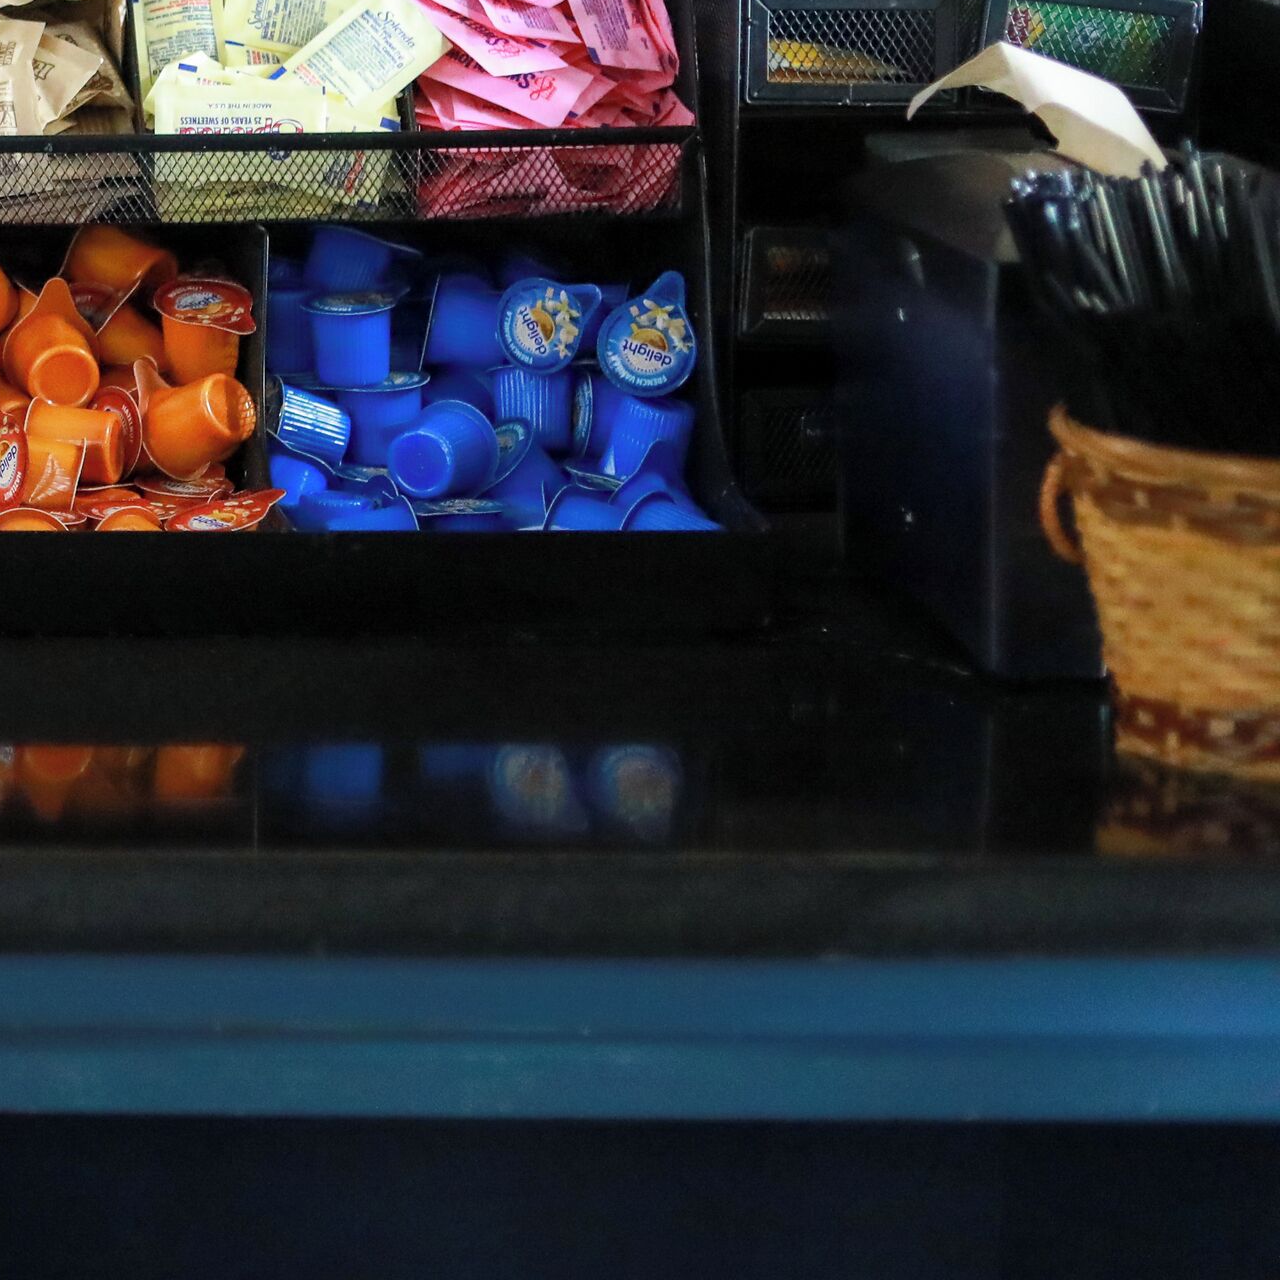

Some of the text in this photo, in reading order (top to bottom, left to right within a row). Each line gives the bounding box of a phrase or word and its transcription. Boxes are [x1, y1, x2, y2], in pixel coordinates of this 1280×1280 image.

[377, 11, 416, 49] Splenda
[180, 116, 262, 126] 25 YEARS OF SWEETNESS
[517, 306, 547, 355] delight
[623, 338, 673, 367] delight
